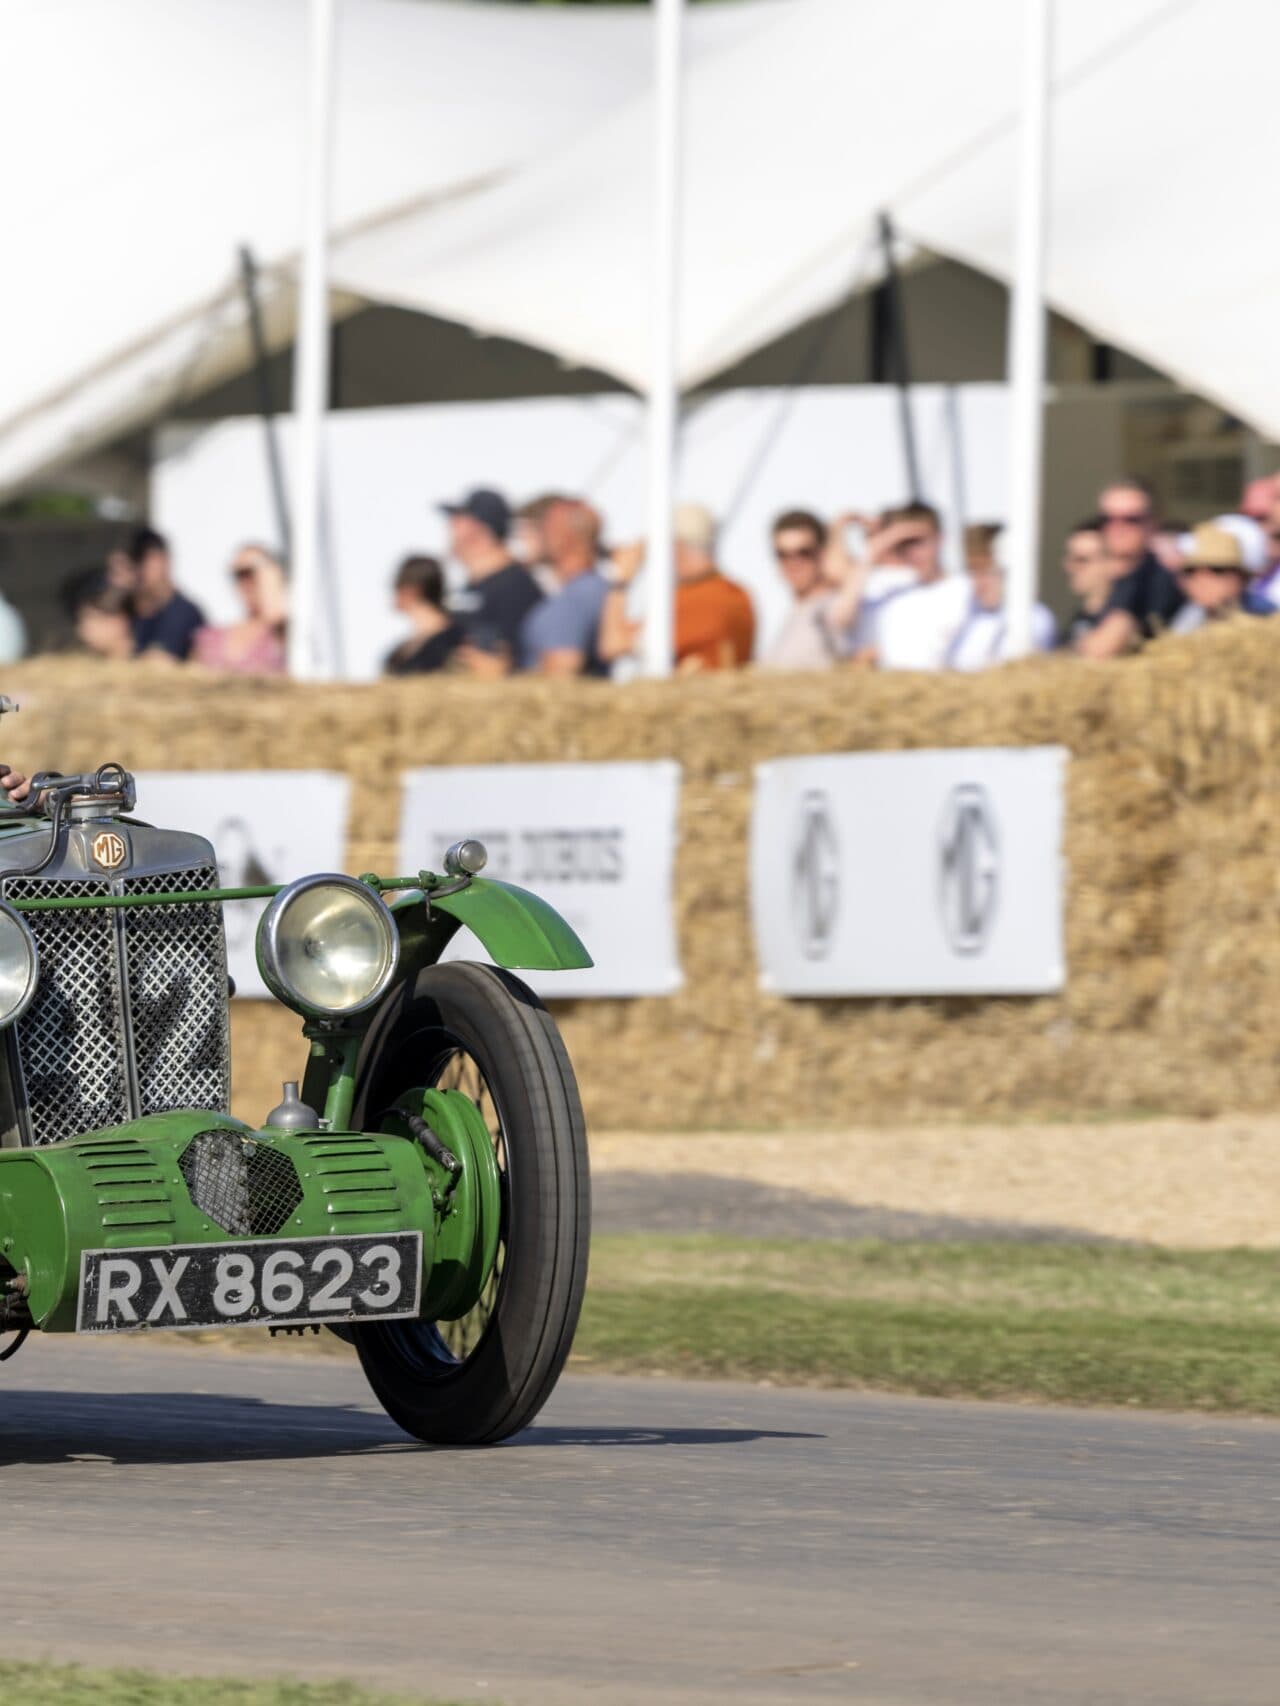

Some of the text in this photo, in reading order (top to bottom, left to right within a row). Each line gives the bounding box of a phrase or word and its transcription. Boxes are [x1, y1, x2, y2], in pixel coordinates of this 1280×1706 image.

[95, 834, 124, 865] MG
[95, 1244, 402, 1323] RX 8623
